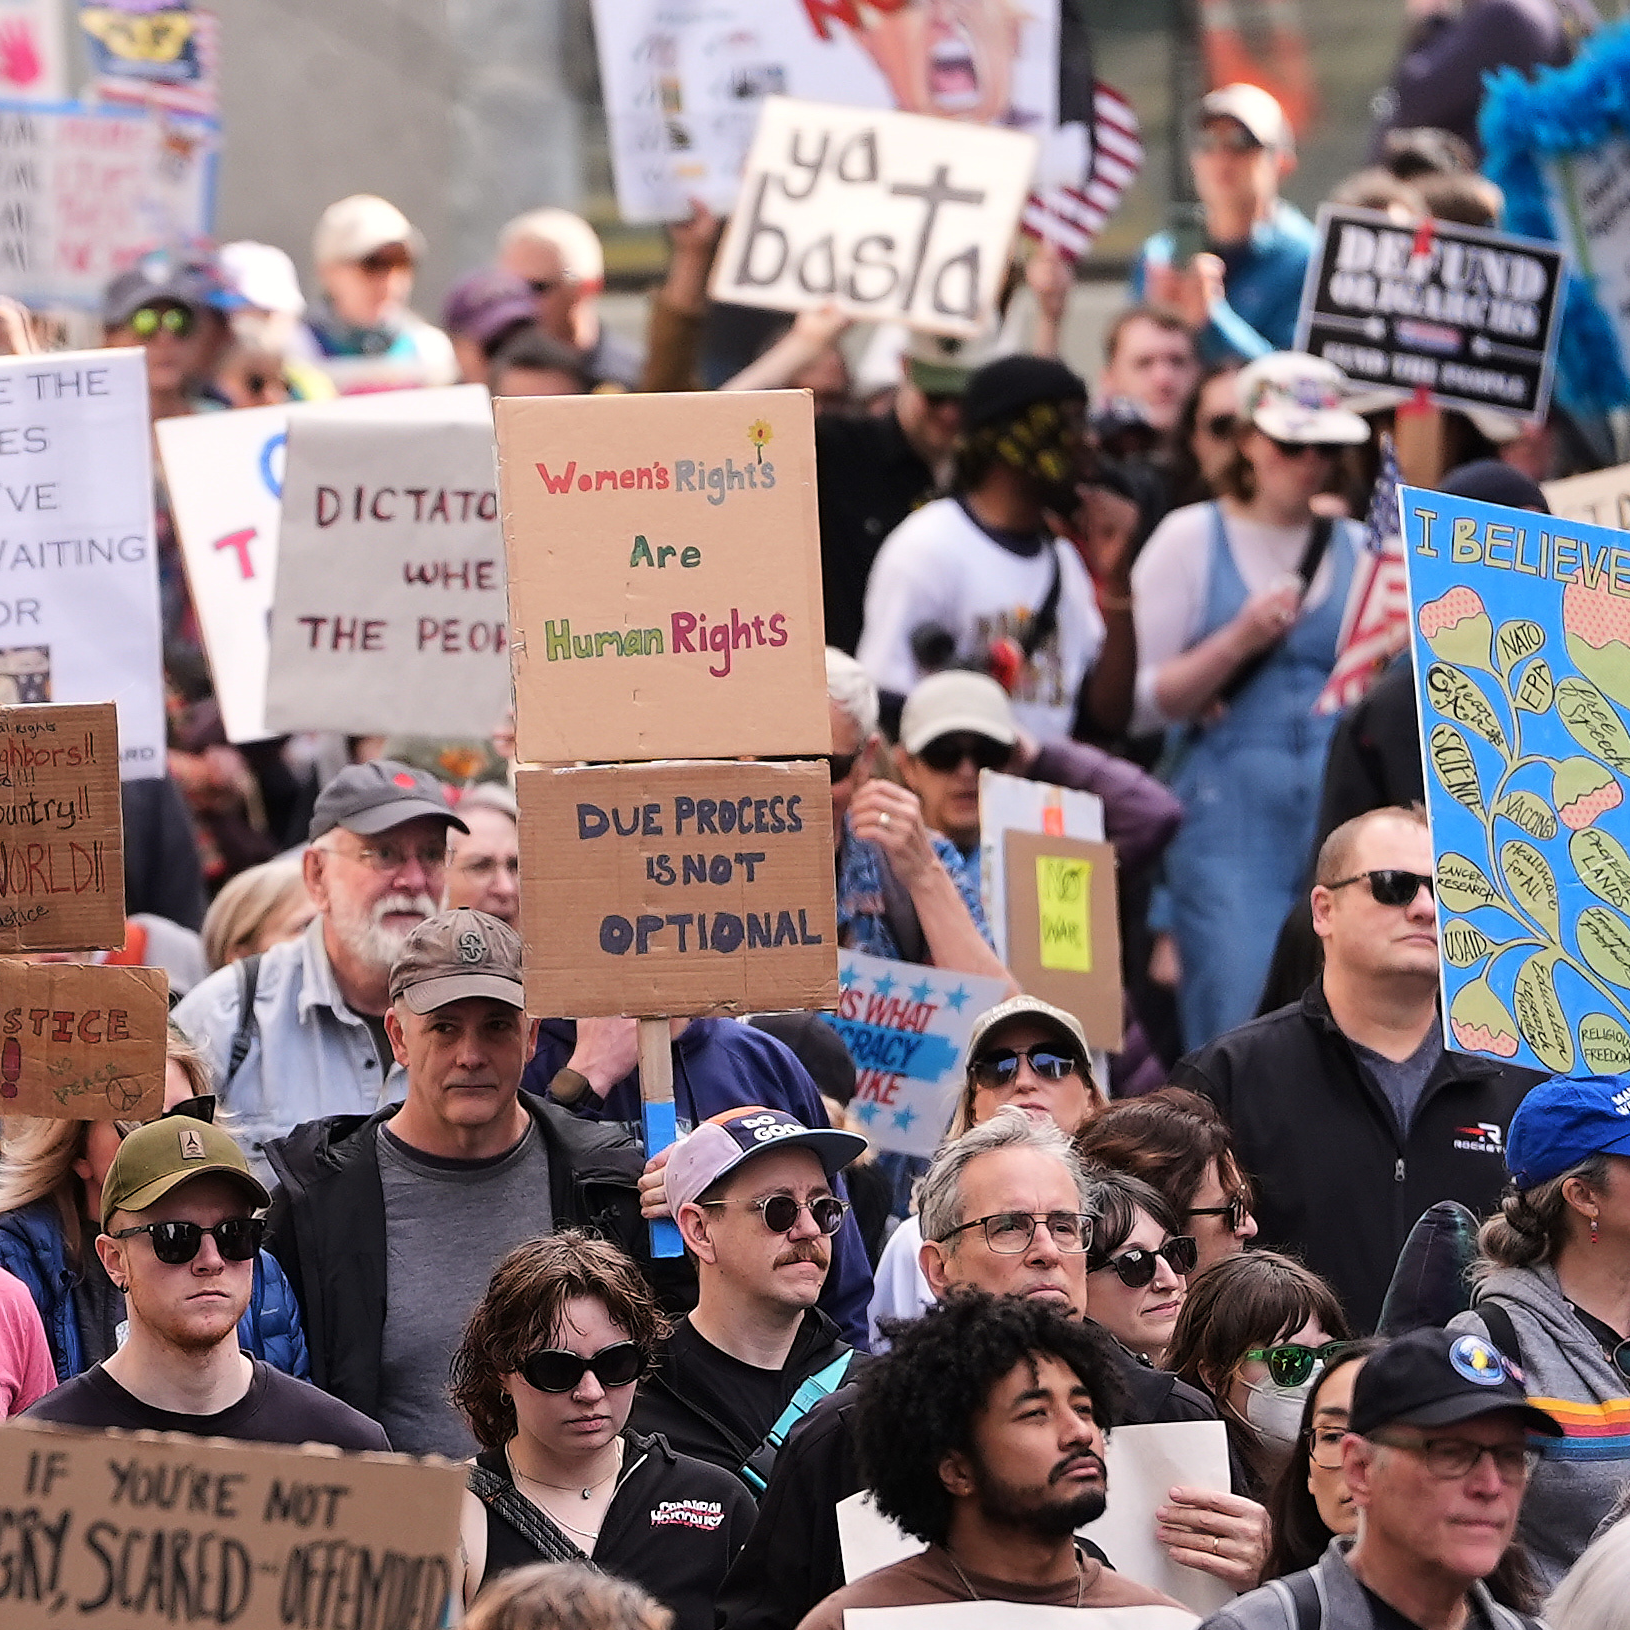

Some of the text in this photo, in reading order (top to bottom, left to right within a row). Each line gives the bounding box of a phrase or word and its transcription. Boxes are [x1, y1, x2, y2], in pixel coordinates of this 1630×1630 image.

[789, 125, 880, 199] ya
[732, 164, 983, 317] basta
[1337, 224, 1548, 302] DEFUND
[26, 368, 111, 400] THE
[535, 460, 671, 496] Women's
[629, 534, 702, 570] Are
[1413, 508, 1439, 558] I
[297, 614, 389, 651] THE
[543, 608, 790, 679] Human Rights
[1500, 622, 1541, 661] NATO
[1520, 663, 1547, 710] EPA
[1431, 726, 1485, 818] SCIENCE
[575, 794, 805, 841] DUE PROCESS
[645, 850, 767, 886] IS NOT
[1436, 865, 1486, 885] CANCER
[1436, 877, 1495, 902] RESEARCH
[597, 906, 823, 958] OPTIONAL
[1445, 930, 1487, 961] USAID
[864, 992, 939, 1034] WHAT
[740, 1115, 776, 1130] DO
[23, 1451, 350, 1531] IF YOU'RE NOT
[80, 1521, 253, 1626] SCARED
